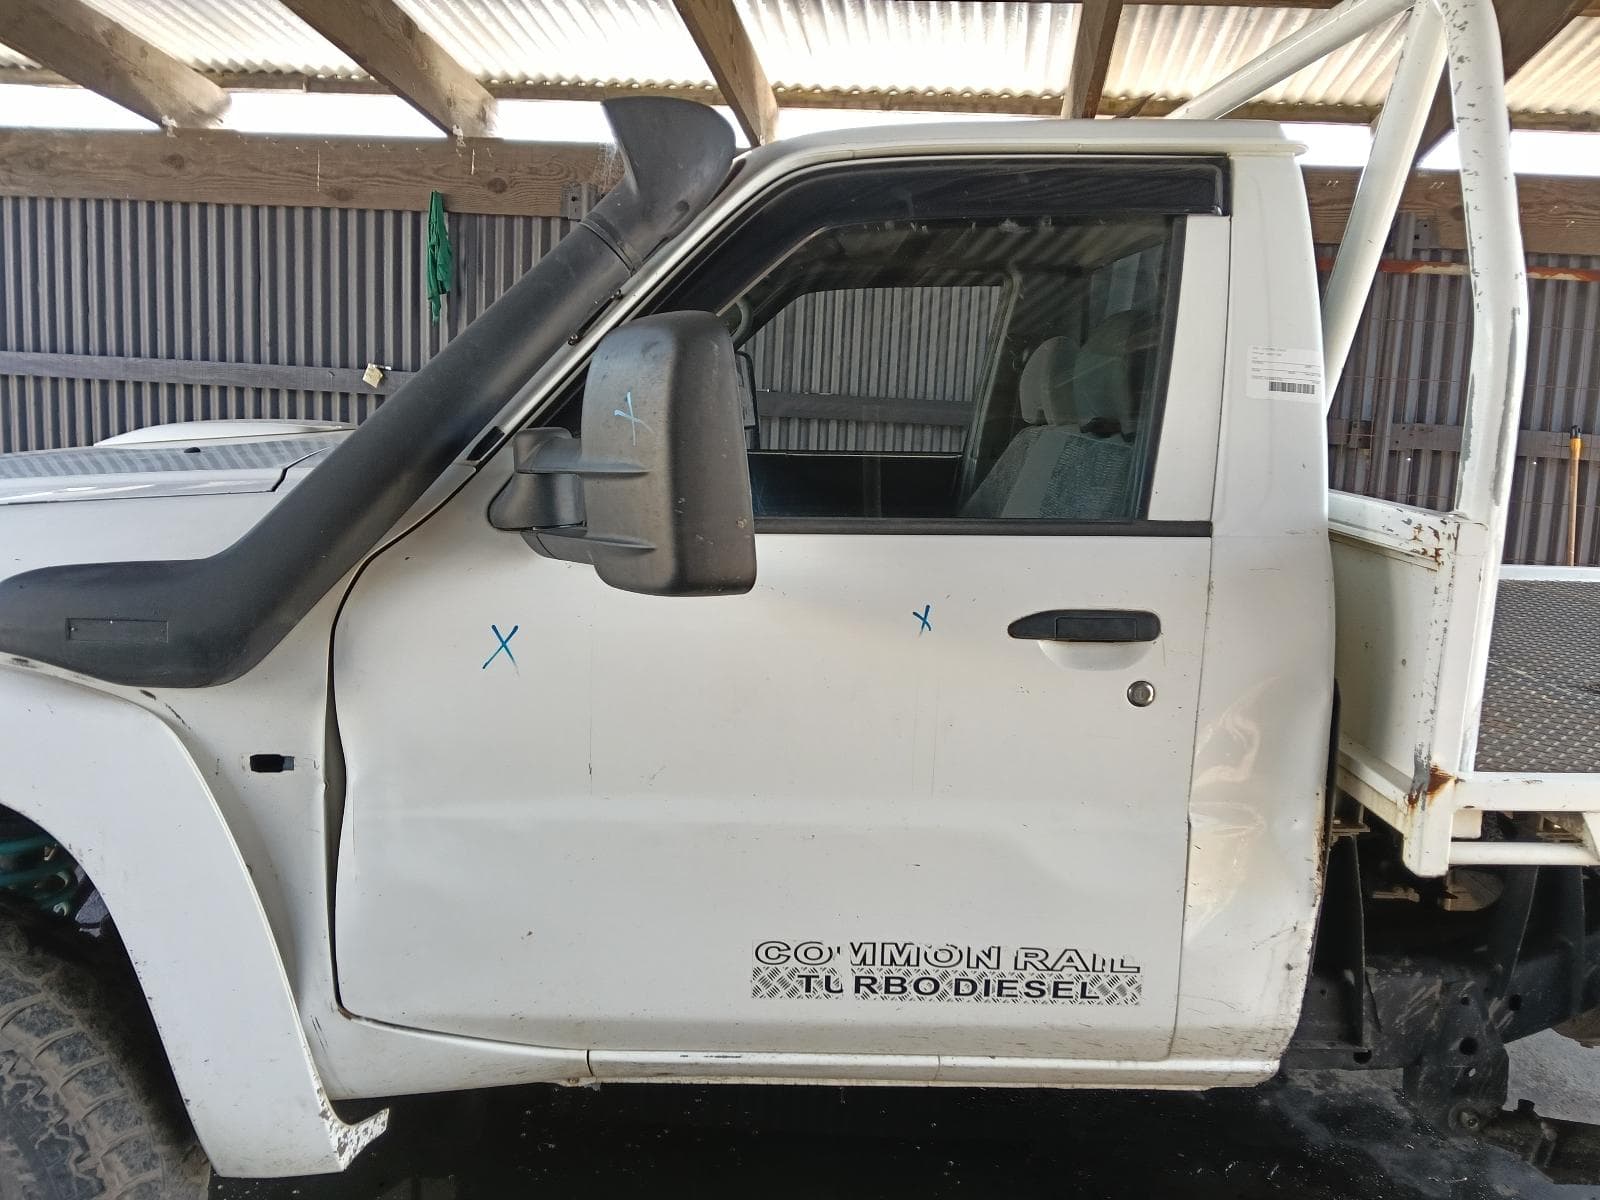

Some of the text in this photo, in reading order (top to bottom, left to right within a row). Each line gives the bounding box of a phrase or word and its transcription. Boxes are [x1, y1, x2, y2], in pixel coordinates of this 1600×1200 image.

[1014, 946, 1141, 974] RAIL
[797, 974, 1100, 1000] TURBO DIESEL
